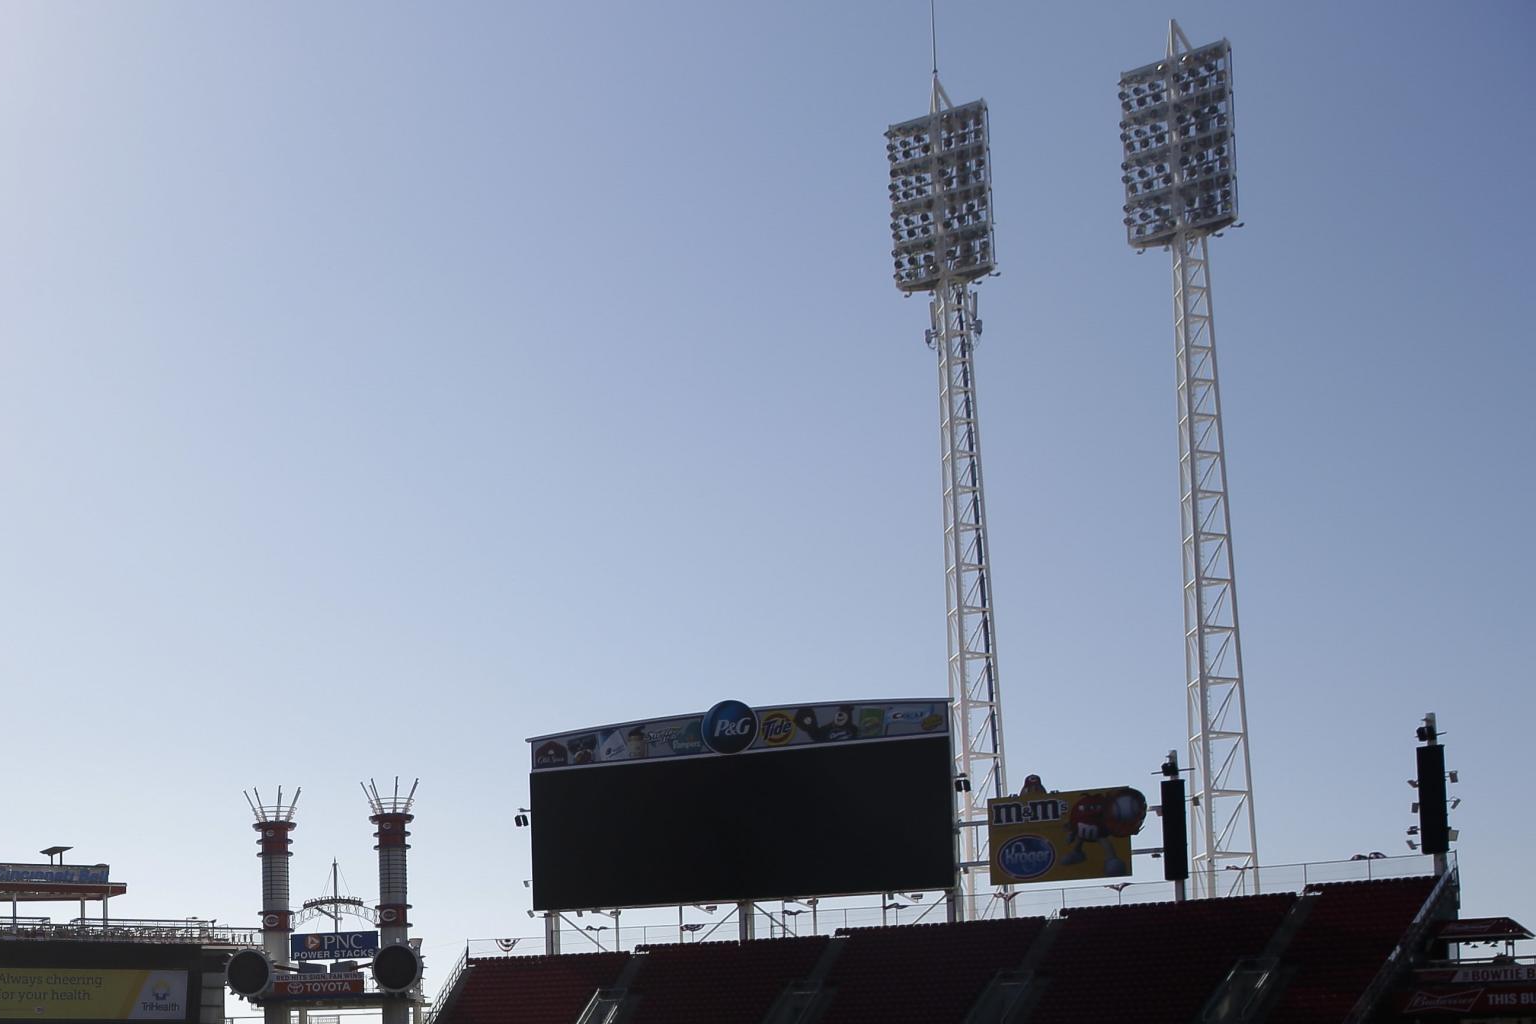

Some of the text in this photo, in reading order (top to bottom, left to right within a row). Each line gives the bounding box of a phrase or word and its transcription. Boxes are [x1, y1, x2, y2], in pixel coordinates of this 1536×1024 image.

[714, 716, 751, 737] P&G
[765, 720, 792, 738] Tide
[1005, 842, 1049, 872] Kroger
[323, 933, 363, 950] PNC
[293, 948, 374, 959] POWER STACKS
[46, 973, 104, 989] cheering
[291, 974, 308, 982] HITS
[1472, 968, 1521, 982] BOWTIE
[305, 982, 352, 993] TOYOTA
[19, 990, 49, 1004] your
[51, 989, 91, 1001] health
[1487, 992, 1518, 1006] THIS
[140, 1001, 180, 1012] TriHealth
